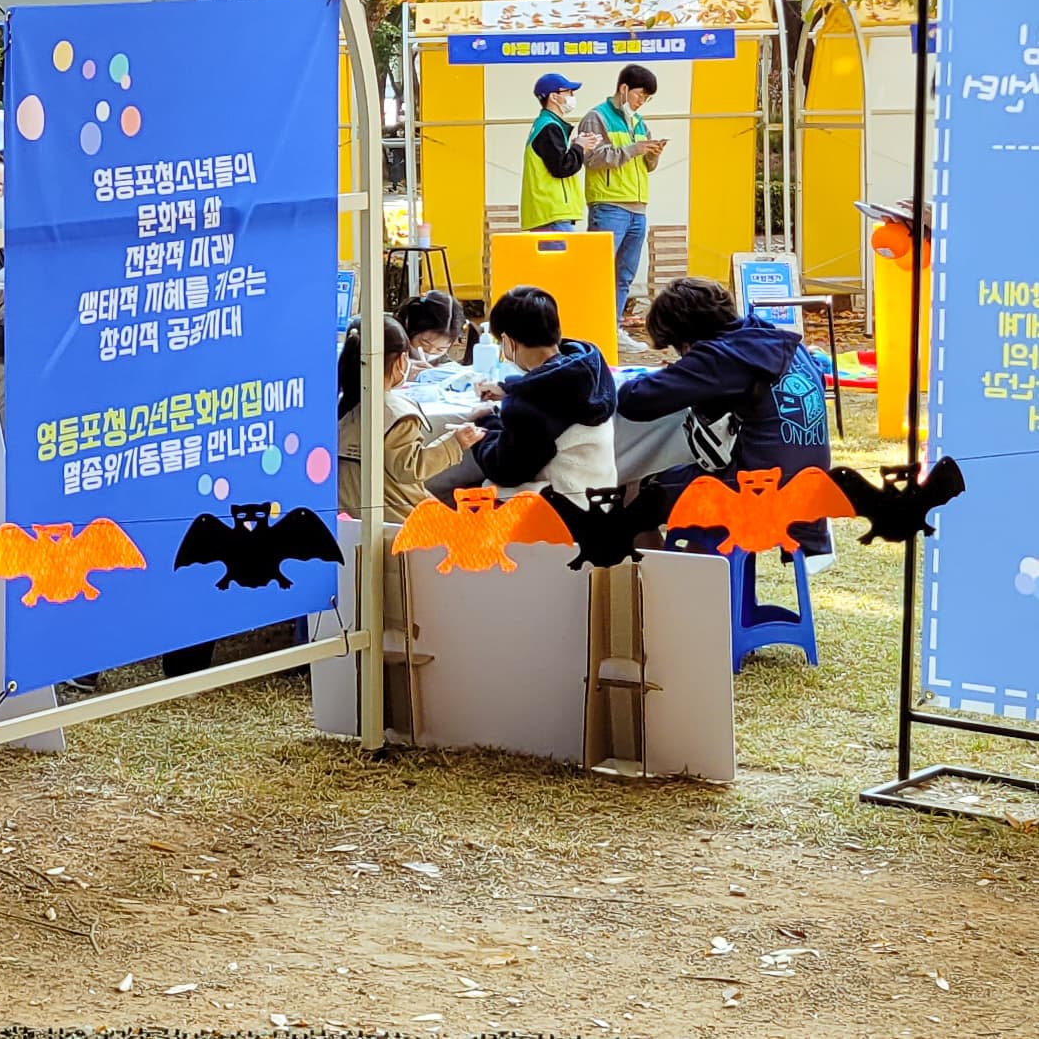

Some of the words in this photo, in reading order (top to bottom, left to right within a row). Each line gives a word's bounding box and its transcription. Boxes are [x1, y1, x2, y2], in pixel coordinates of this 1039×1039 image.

[502, 41, 560, 56] 아동에게
[93, 152, 256, 202] 영등포청소년들의
[138, 199, 195, 238] 문화적
[203, 196, 222, 229] 삶
[125, 240, 184, 278] 전환적
[189, 233, 234, 267] 미래
[78, 285, 139, 325] 생태적
[144, 275, 209, 313] 지혜를
[214, 265, 267, 301] 키우는
[99, 320, 159, 362] 창의적
[167, 304, 242, 351] 공공지대
[36, 377, 304, 462] 영등포청소년문화의집에서
[781, 421, 802, 445] ON
[63, 435, 202, 495] 멸종위기동물을
[206, 420, 274, 462] 만나요!
